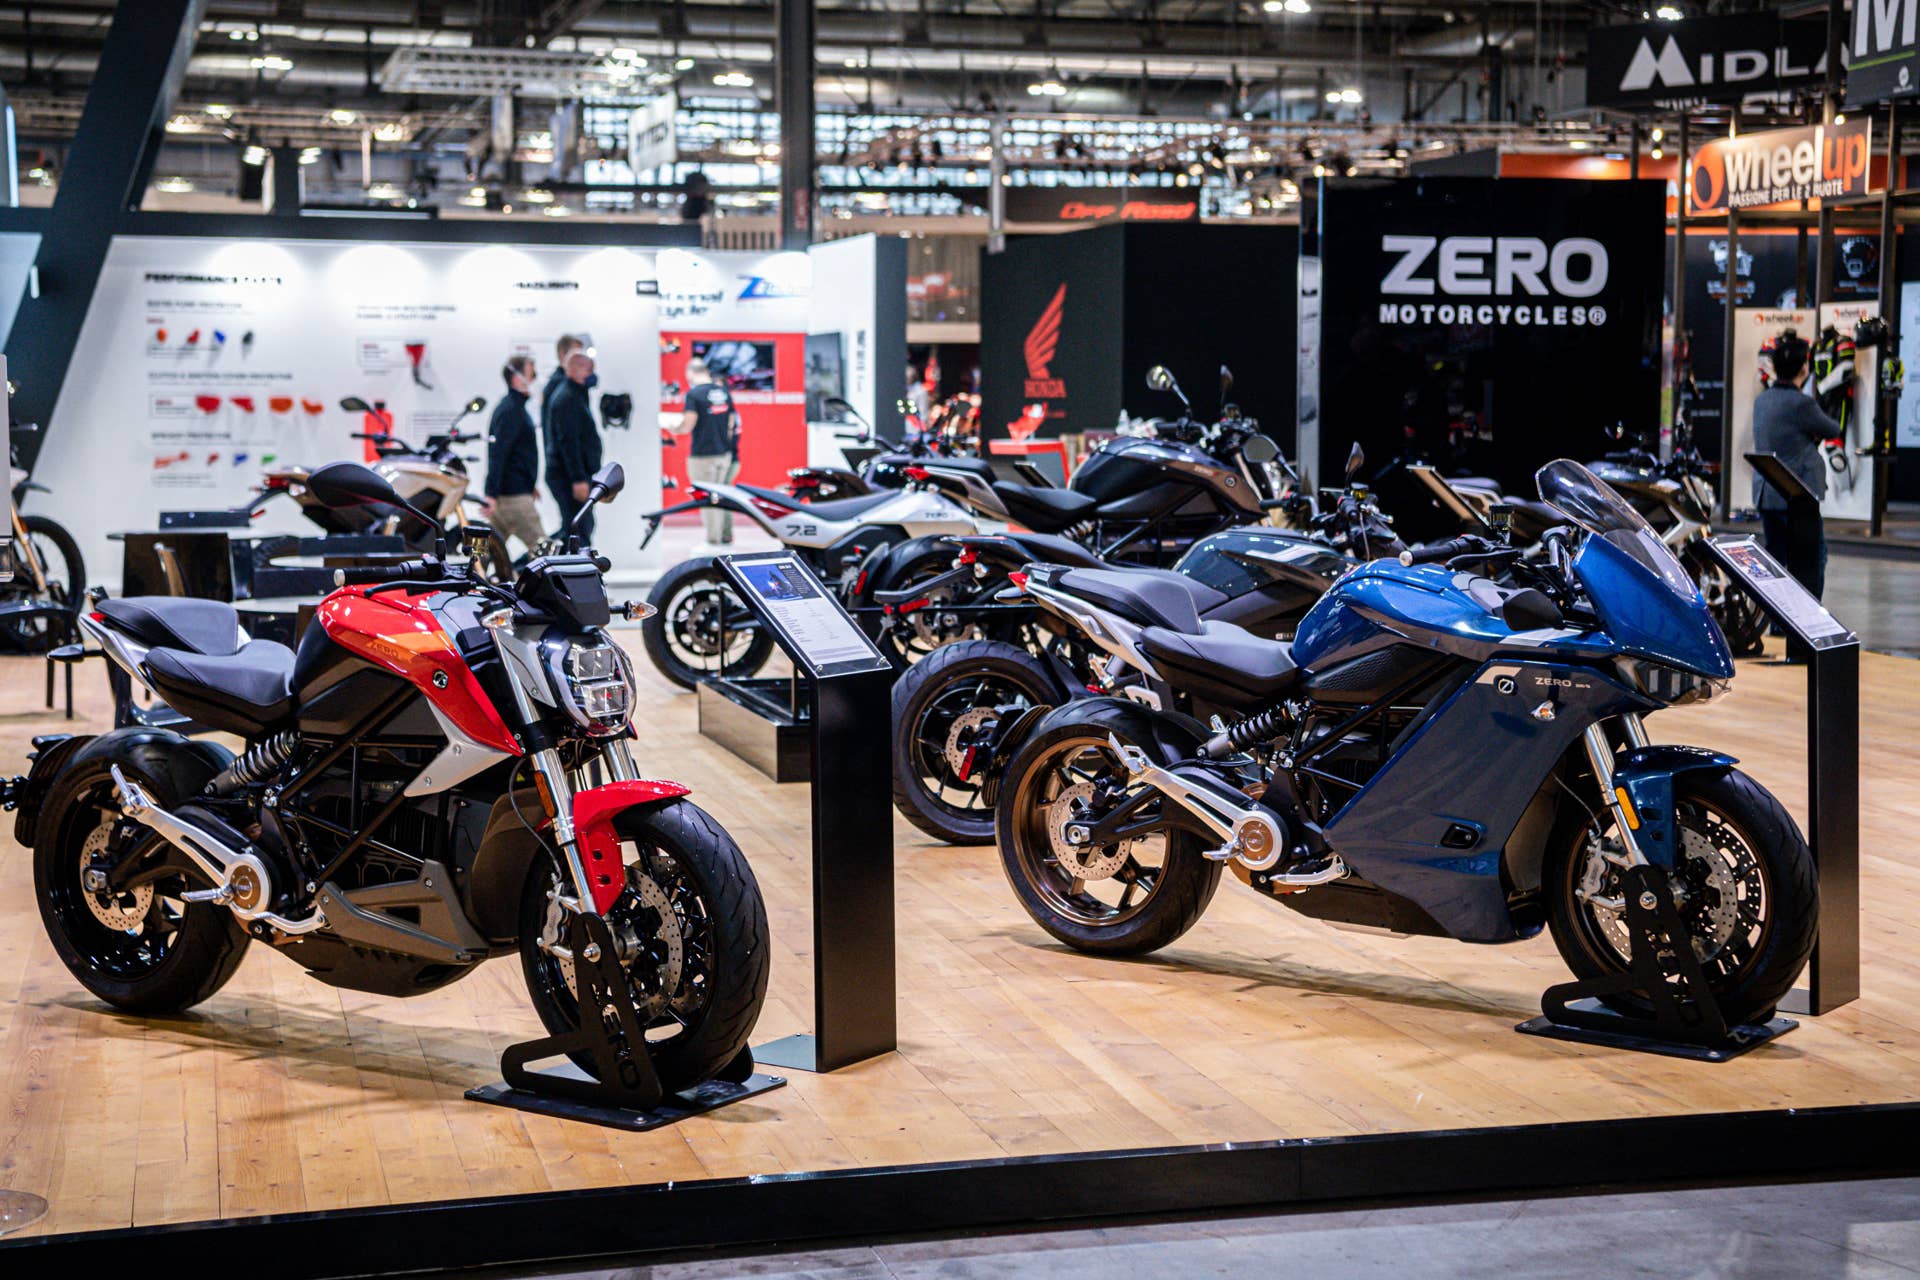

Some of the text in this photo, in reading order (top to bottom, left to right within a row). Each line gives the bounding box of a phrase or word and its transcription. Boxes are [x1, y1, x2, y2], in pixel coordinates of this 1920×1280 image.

[1728, 178, 1843, 208] PASSIONE PER LE 2 RUOTE
[1380, 234, 1609, 298] ZERO
[1534, 676, 1572, 687] ZERO
